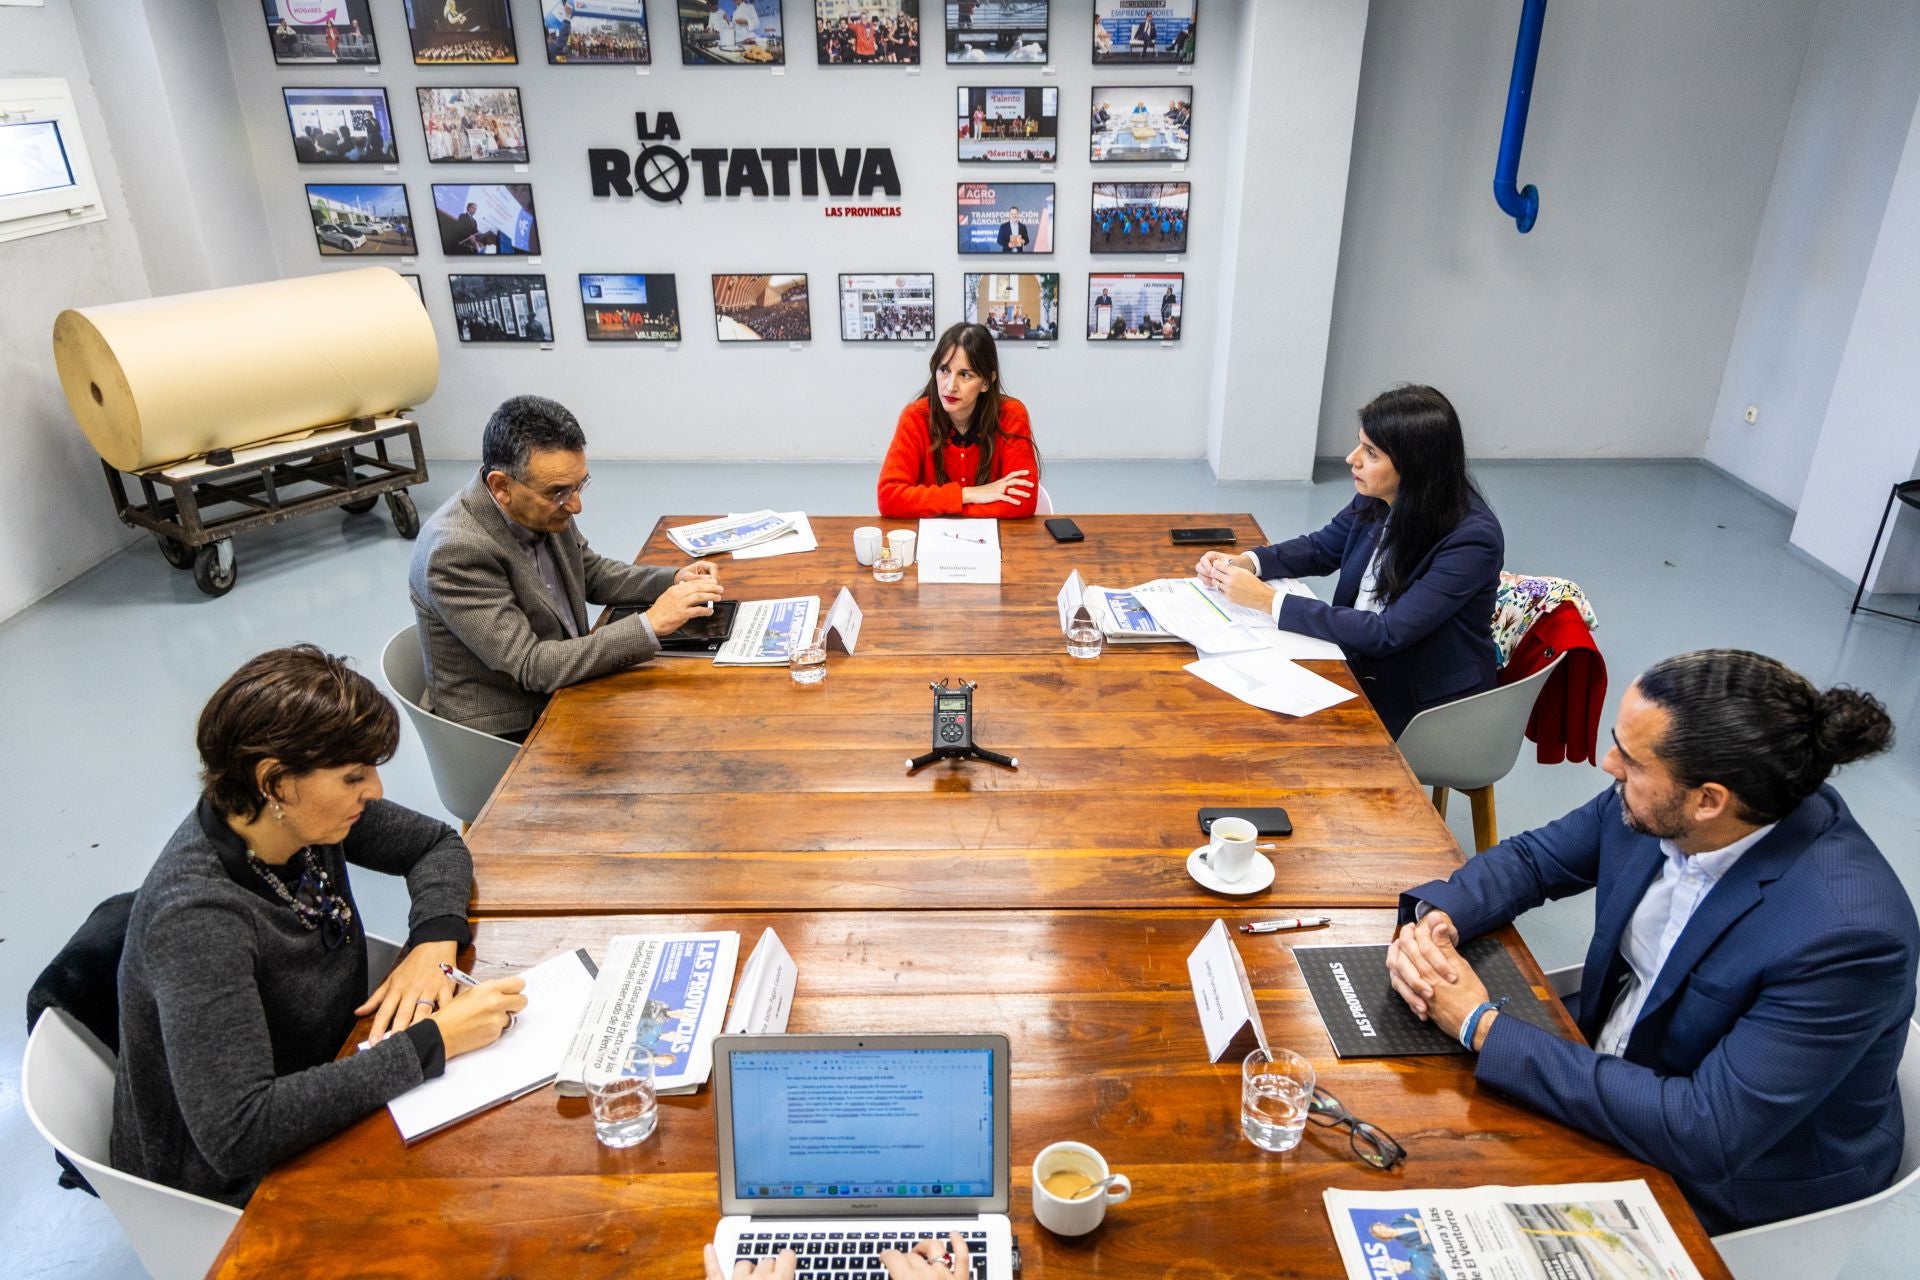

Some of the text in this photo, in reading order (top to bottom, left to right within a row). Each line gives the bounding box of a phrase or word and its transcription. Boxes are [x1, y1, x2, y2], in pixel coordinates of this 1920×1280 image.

[635, 112, 681, 140] LA
[588, 143, 902, 203] ROTATIVA
[966, 189, 996, 198] AGRO
[825, 207, 902, 217] LAS PROVINCIAS
[971, 210, 1039, 218] TRANSFORCIÓN
[595, 309, 644, 325] INNVA
[642, 949, 656, 969] jueza
[695, 942, 717, 970] LAS
[639, 969, 649, 979] de
[613, 980, 631, 1014] reservado
[630, 985, 642, 1003] dana
[1329, 962, 1377, 1037] LAS PROVINCIAS
[609, 1016, 619, 1026] de
[671, 971, 712, 1054] PROVINCIAS
[606, 1026, 616, 1034] El
[594, 1035, 613, 1069] Venrro
[1429, 1207, 1442, 1222] las
[1435, 1223, 1449, 1231] y
[1444, 1209, 1471, 1257] Ventorro
[1440, 1232, 1463, 1269] factura
[1364, 1242, 1399, 1280] IAS
[1463, 1259, 1477, 1268] El
